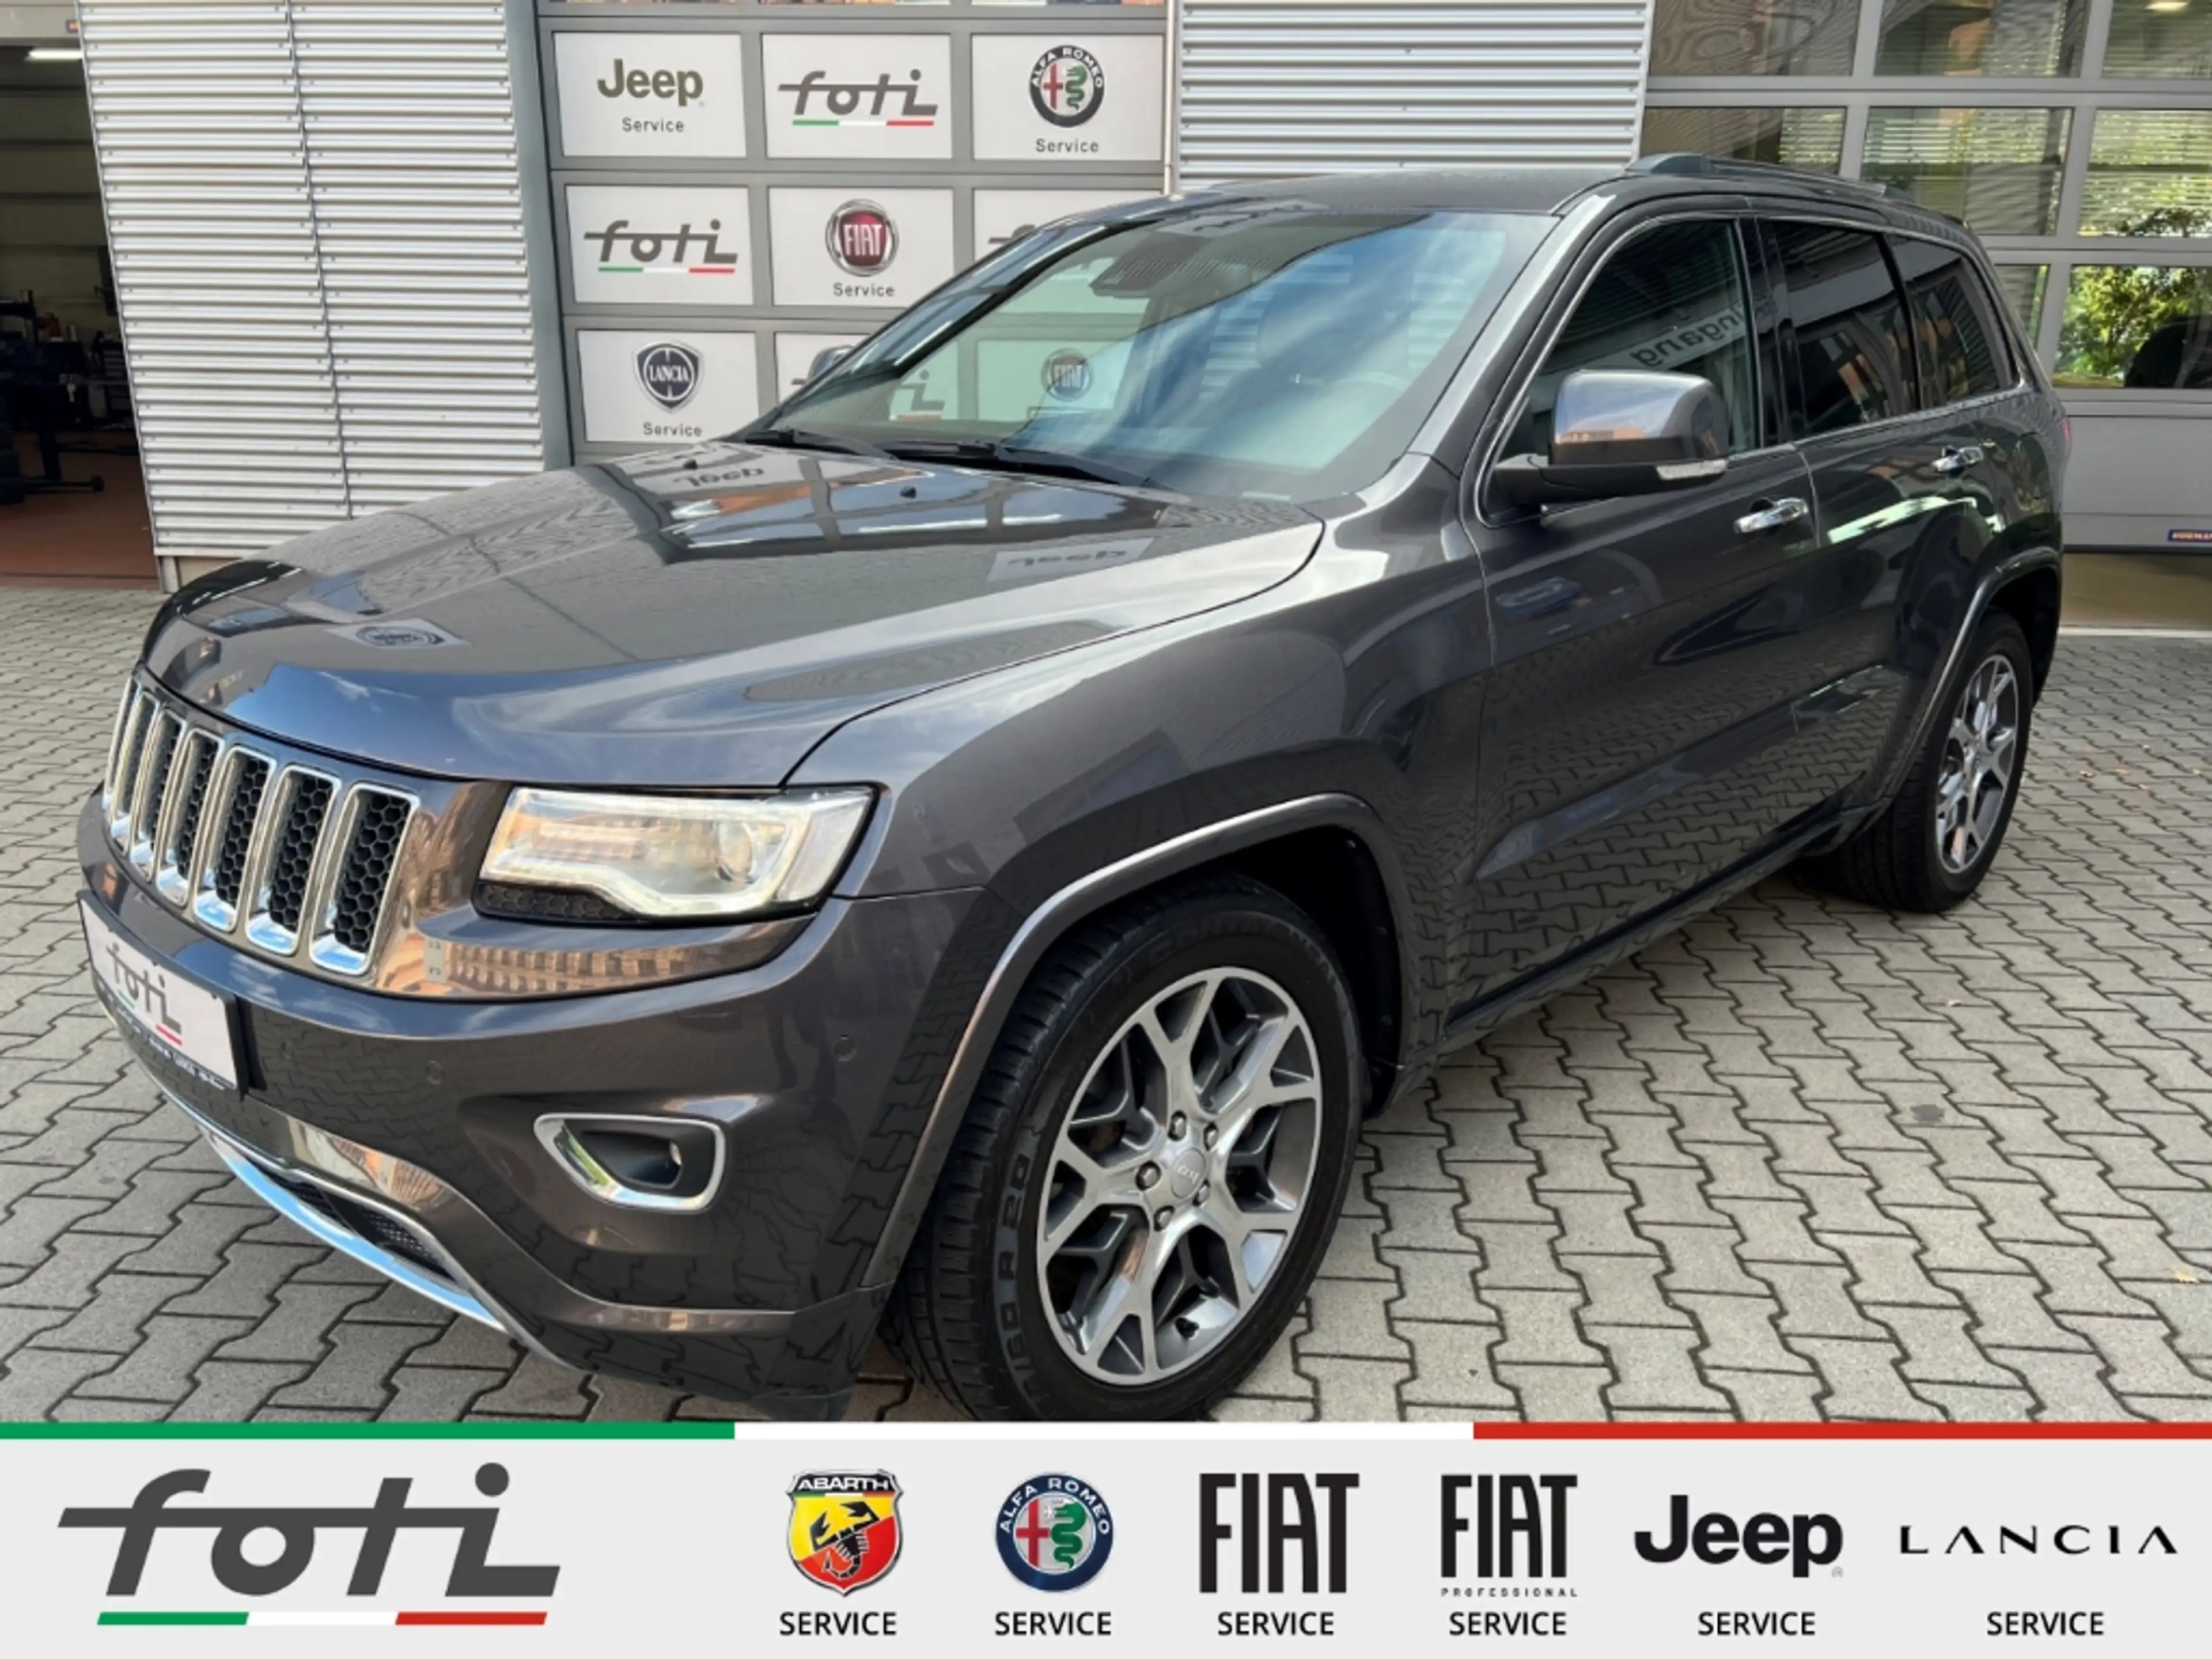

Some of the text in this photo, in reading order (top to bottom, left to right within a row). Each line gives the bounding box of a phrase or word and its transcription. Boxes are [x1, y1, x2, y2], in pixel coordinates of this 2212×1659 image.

[1031, 47, 1103, 88] ALFA ROMEO
[597, 59, 703, 107] Jeep
[778, 69, 938, 116] foti
[622, 118, 684, 132] Service
[1036, 138, 1099, 153] Service
[584, 219, 738, 264] foti
[843, 224, 882, 256] FIAT
[834, 282, 895, 297] Service
[647, 365, 690, 382] LANCIA
[643, 422, 702, 437] Service
